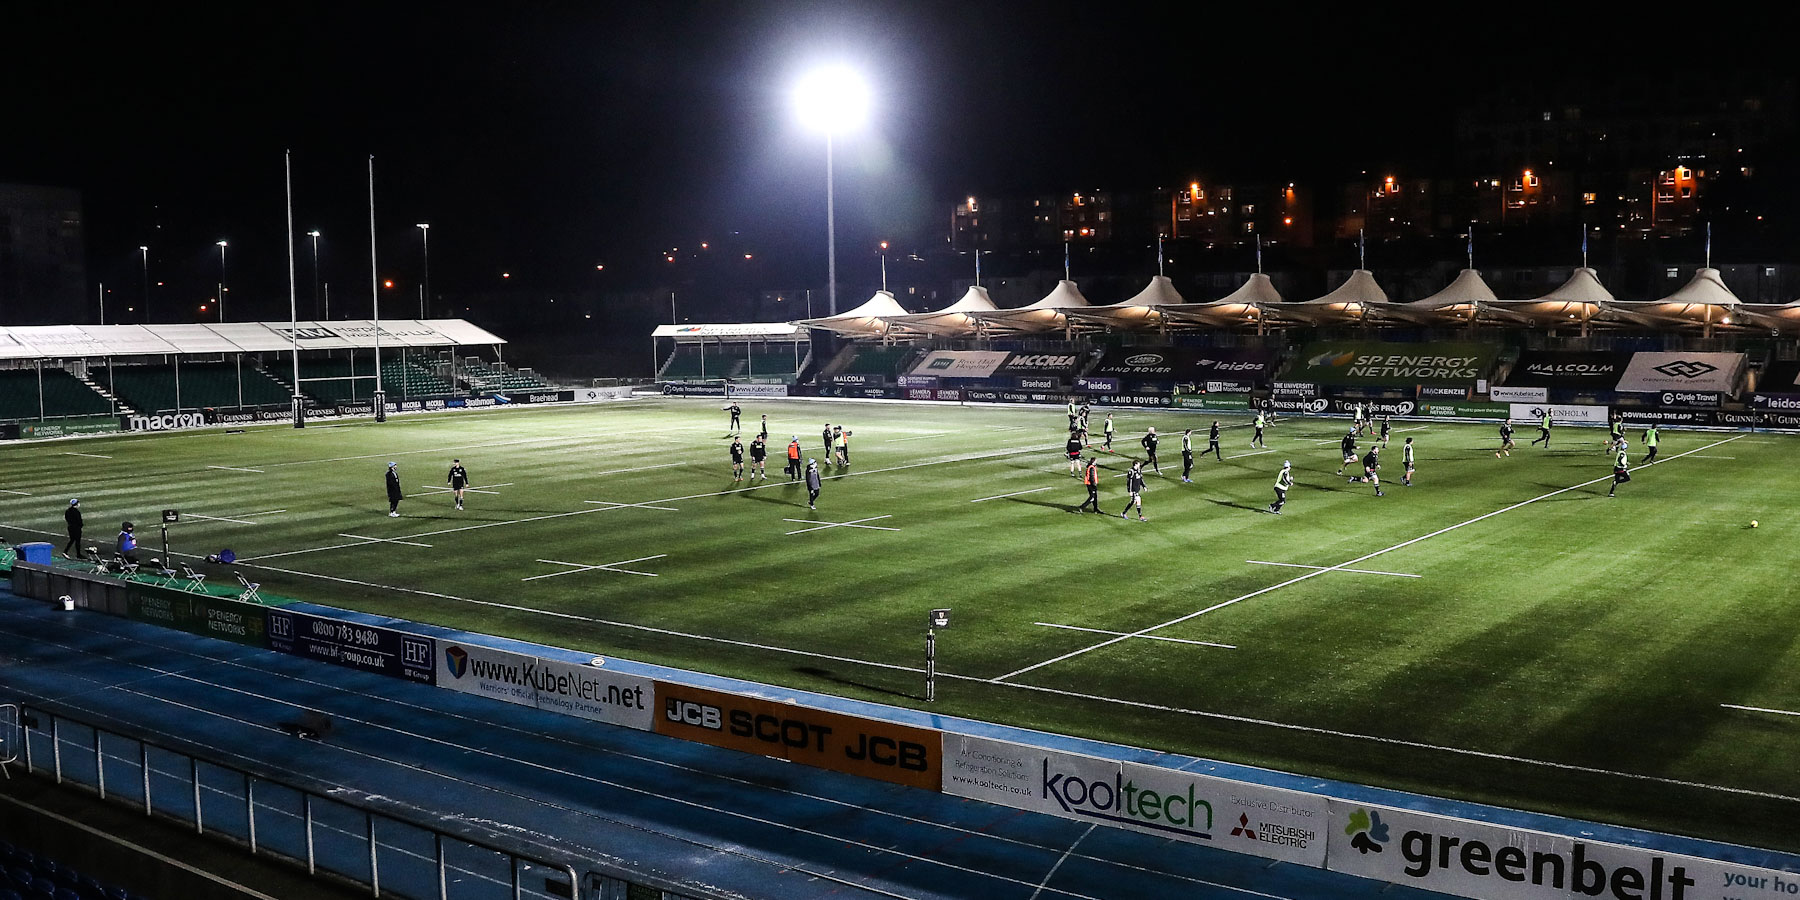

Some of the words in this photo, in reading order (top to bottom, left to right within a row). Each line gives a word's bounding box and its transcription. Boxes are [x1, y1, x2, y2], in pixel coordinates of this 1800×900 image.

[1008, 355, 1076, 366] MCCREA
[1213, 361, 1264, 371] leidos
[1355, 355, 1382, 365] SP
[1385, 356, 1477, 368] ENERGY
[1347, 367, 1479, 378] NETWORKS
[1527, 363, 1614, 372] MALCOLM
[1022, 380, 1051, 388] Braehead
[1087, 381, 1111, 390] leidos
[464, 398, 495, 407] Strathmore
[530, 394, 558, 402] Braehead
[1111, 395, 1131, 403] LAND
[1132, 396, 1159, 405] ROVER
[1261, 400, 1296, 408] GNNESS
[1676, 393, 1695, 402] Clyde
[1696, 393, 1718, 401] Travel
[1768, 398, 1800, 409] leidos
[263, 409, 292, 419] GUINNESS
[307, 408, 335, 417] GUINNESS
[345, 404, 372, 414] GUINNESS
[1553, 409, 1589, 417] ENHOLM
[1622, 411, 1662, 419] DOWNLOAD
[131, 413, 205, 430] macron
[223, 412, 254, 423] GUINNESS
[148, 597, 171, 610] ENERGY
[141, 606, 174, 621] NETWORKS
[216, 609, 242, 622] ENERGY
[208, 620, 246, 636] NETWORKS
[271, 615, 291, 636] HF
[312, 621, 334, 635] 0800
[335, 625, 353, 642] 783
[355, 630, 379, 645] 9480
[309, 643, 384, 668] www.hf-group.co.uk
[404, 641, 428, 663] HF
[413, 669, 429, 681] Group
[471, 659, 645, 710] www.KubeNet.net
[511, 686, 534, 700] Official
[575, 702, 602, 715] Partner
[667, 699, 722, 731] JCB
[730, 709, 832, 752] SCOT
[845, 734, 927, 771] JCB
[1017, 758, 1023, 767] &
[955, 759, 997, 775] Refrigeration
[998, 767, 1029, 782] Solutions
[952, 774, 1032, 797] www.kooltech.co.uk
[1043, 757, 1213, 831] kooltech
[1231, 795, 1268, 810] Exclusive
[1270, 800, 1315, 818] Distributor
[1260, 821, 1316, 846] MITSUBISHI
[1260, 831, 1308, 854] ELECTRIC
[1401, 828, 1693, 900] greenbelt
[1724, 872, 1768, 889] your
[1774, 876, 1799, 894] ho
